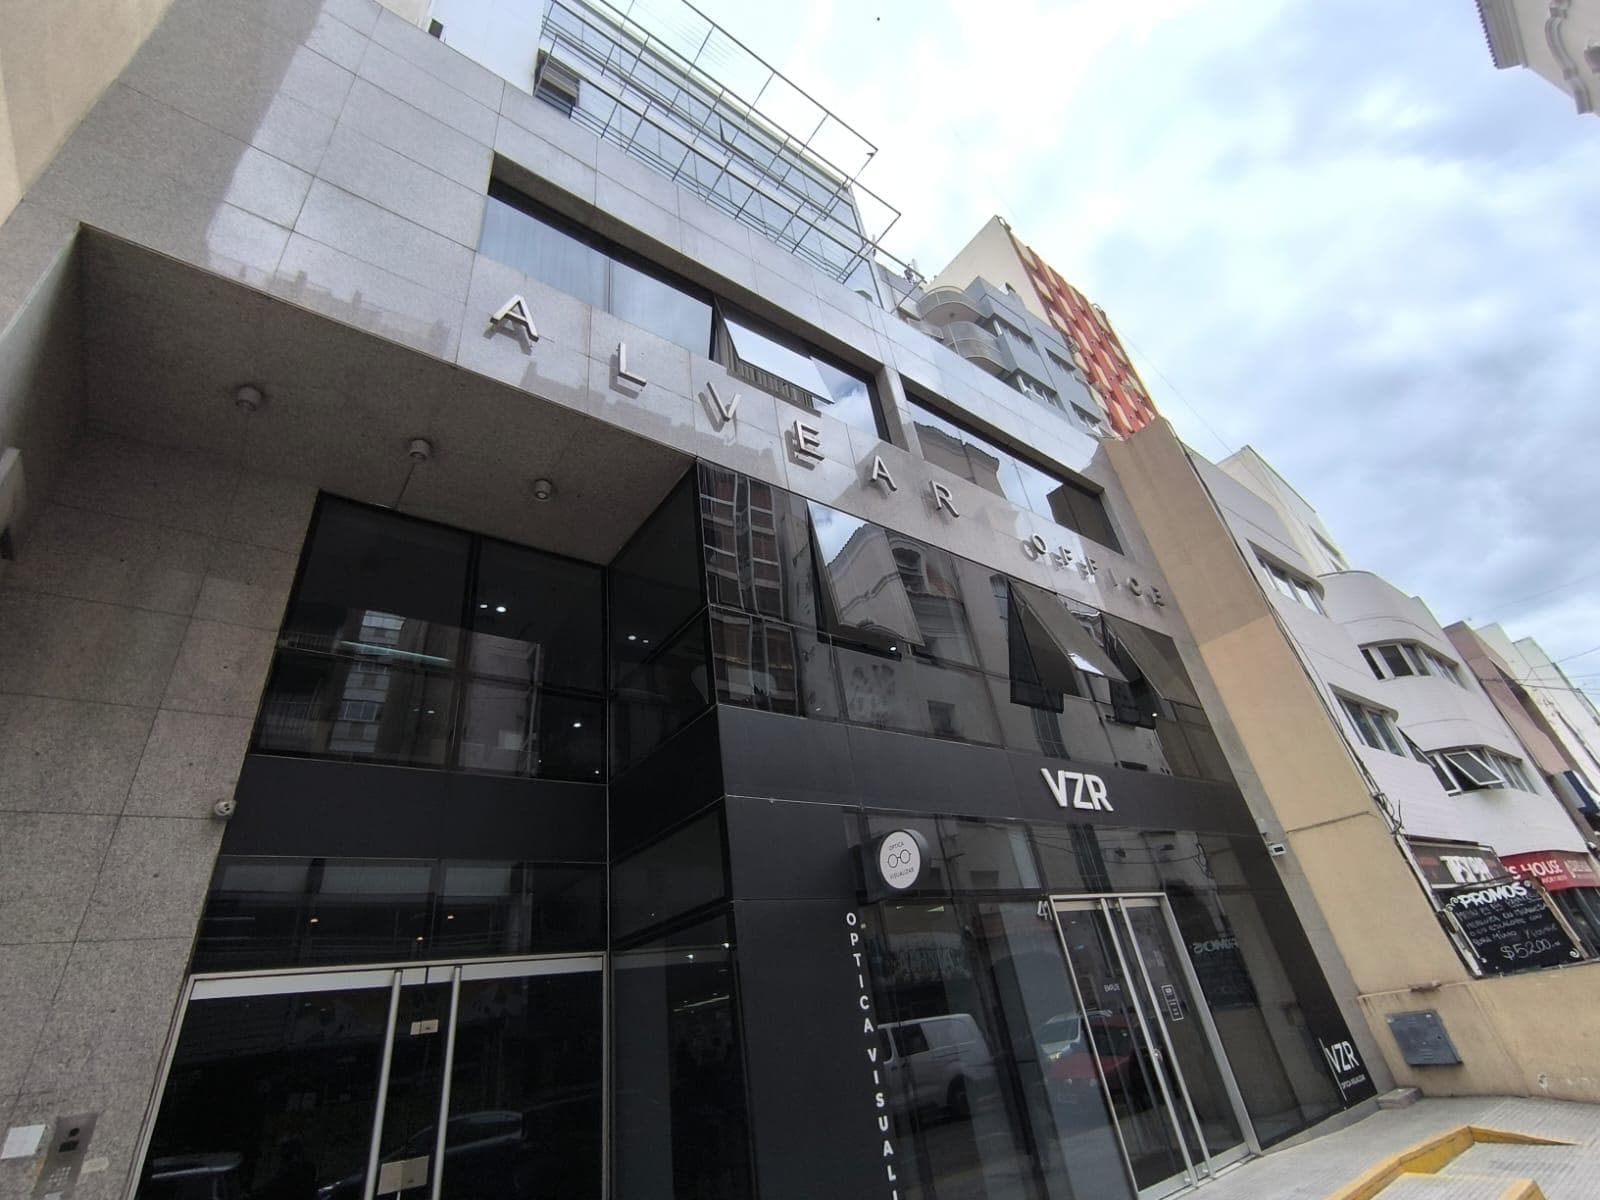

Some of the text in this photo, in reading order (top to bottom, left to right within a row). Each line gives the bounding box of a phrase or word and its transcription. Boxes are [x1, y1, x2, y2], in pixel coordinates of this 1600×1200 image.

[489, 294, 1166, 607] ALVEAR OFFICE
[1040, 768, 1114, 812] VZR
[1520, 859, 1563, 877] HOUSE
[1457, 882, 1527, 909] PROMOS
[846, 912, 874, 1033] OPTICA
[1324, 1041, 1360, 1073] VZR
